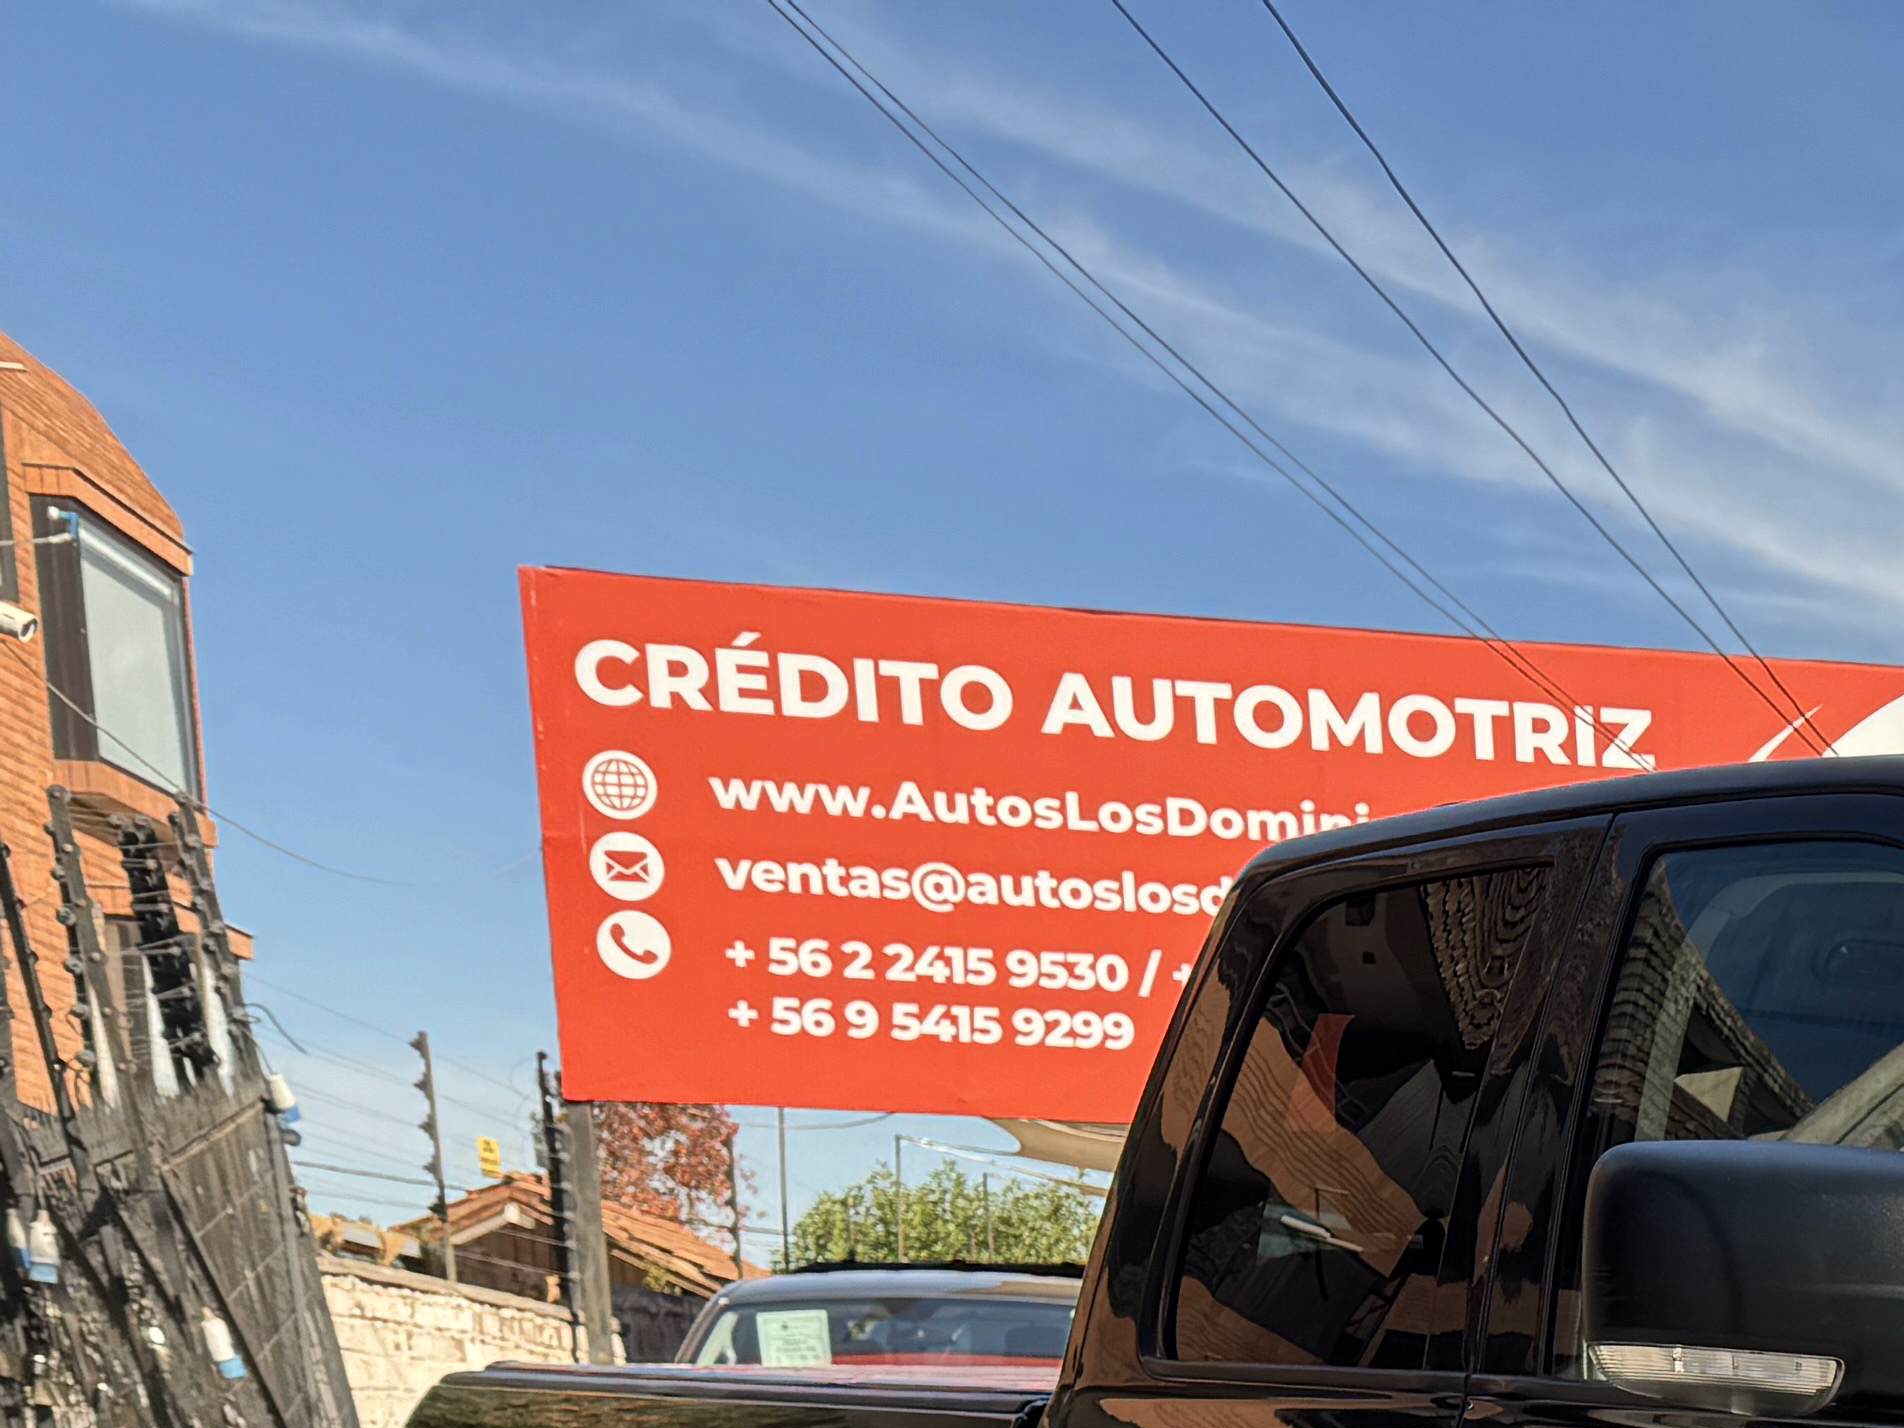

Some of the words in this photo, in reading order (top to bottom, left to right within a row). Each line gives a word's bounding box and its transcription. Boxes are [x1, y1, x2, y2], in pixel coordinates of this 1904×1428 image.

[575, 632, 1013, 731] CRÉDITO
[1041, 672, 1655, 771] AUTOMOTRIZ
[725, 940, 755, 968] +
[768, 937, 832, 978] 56
[841, 942, 875, 979] 2
[885, 945, 997, 986] 2415
[1005, 950, 1129, 993] 9530
[1138, 949, 1162, 998] /
[728, 1000, 758, 1028] +
[770, 997, 835, 1037] 56
[844, 1001, 880, 1039] 9
[891, 1003, 1003, 1045] 5415
[1011, 1008, 1135, 1050] 9299
